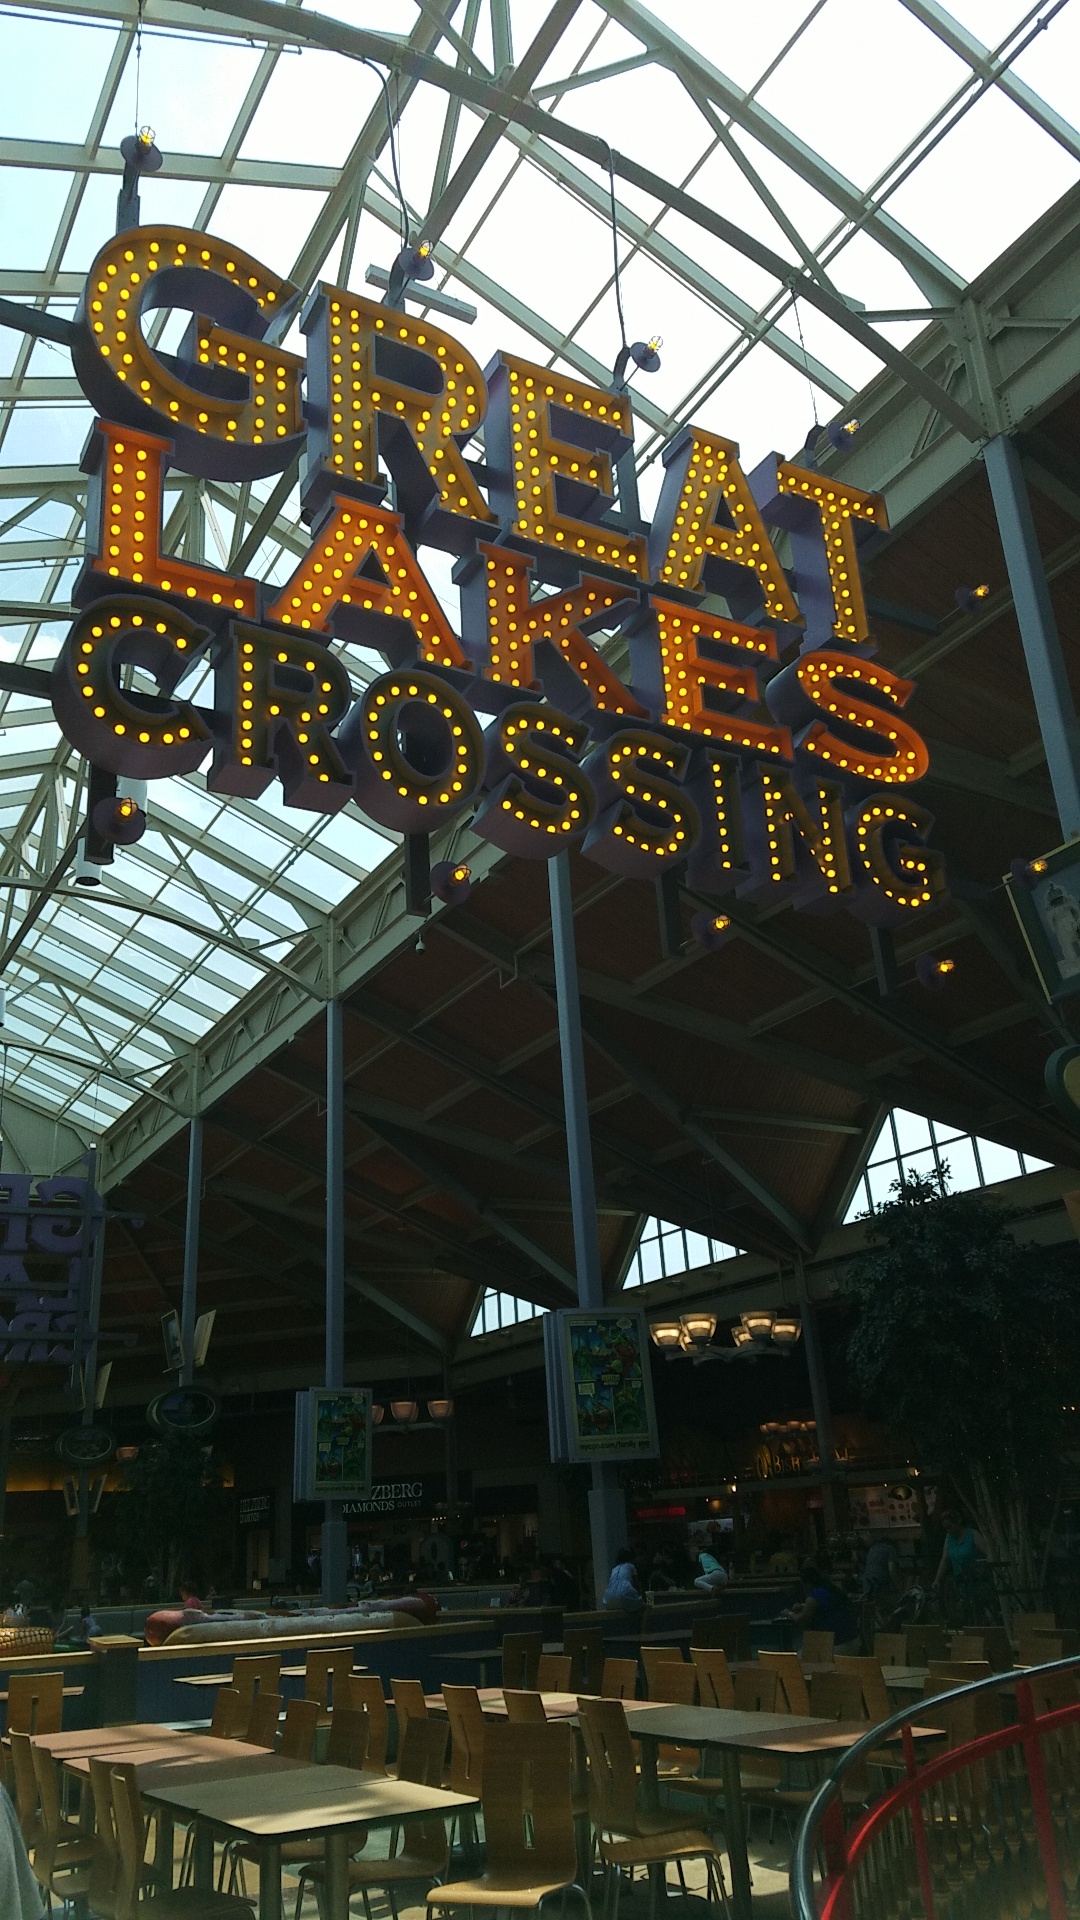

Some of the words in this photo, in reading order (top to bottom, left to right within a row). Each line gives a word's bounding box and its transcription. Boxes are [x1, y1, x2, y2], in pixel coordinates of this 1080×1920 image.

[78, 225, 890, 648] GREAT
[60, 594, 945, 915] CROSSING
[84, 418, 930, 786] LAKES
[371, 1482, 423, 1500] ZBERG
[397, 1500, 421, 1508] OUTLET
